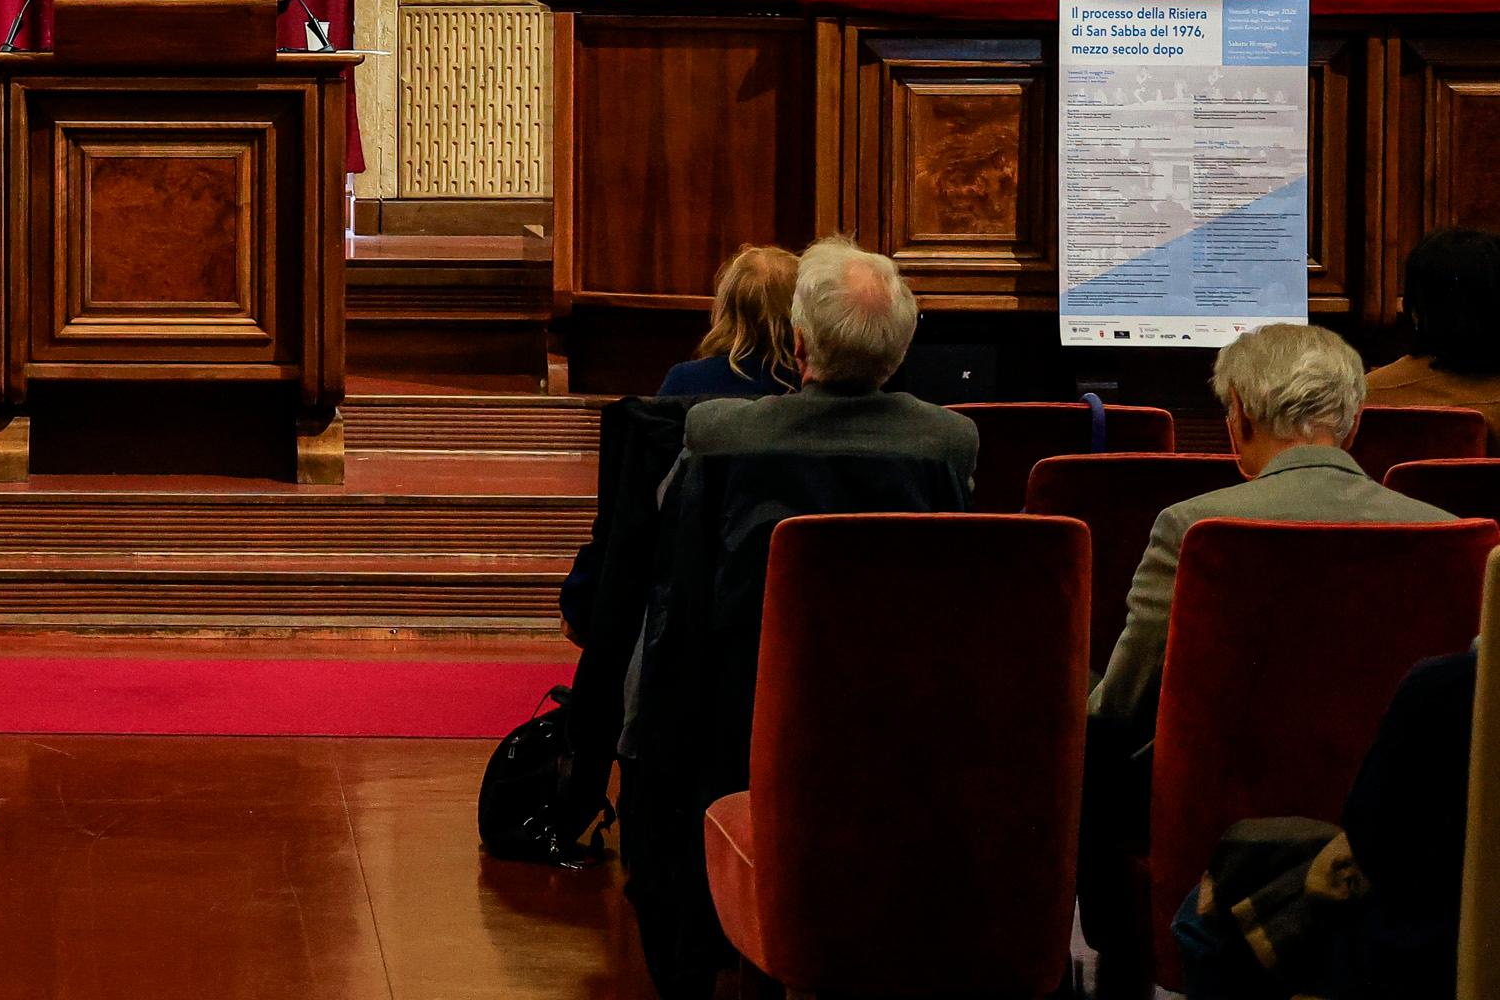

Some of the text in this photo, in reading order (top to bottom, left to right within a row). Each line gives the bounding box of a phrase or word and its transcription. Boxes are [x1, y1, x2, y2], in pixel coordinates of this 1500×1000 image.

[1072, 7, 1207, 21] Il processo della Risiera
[1072, 25, 1205, 38] di San Sabba del 1976,
[1072, 42, 1184, 57] mezzo secolo dopo
